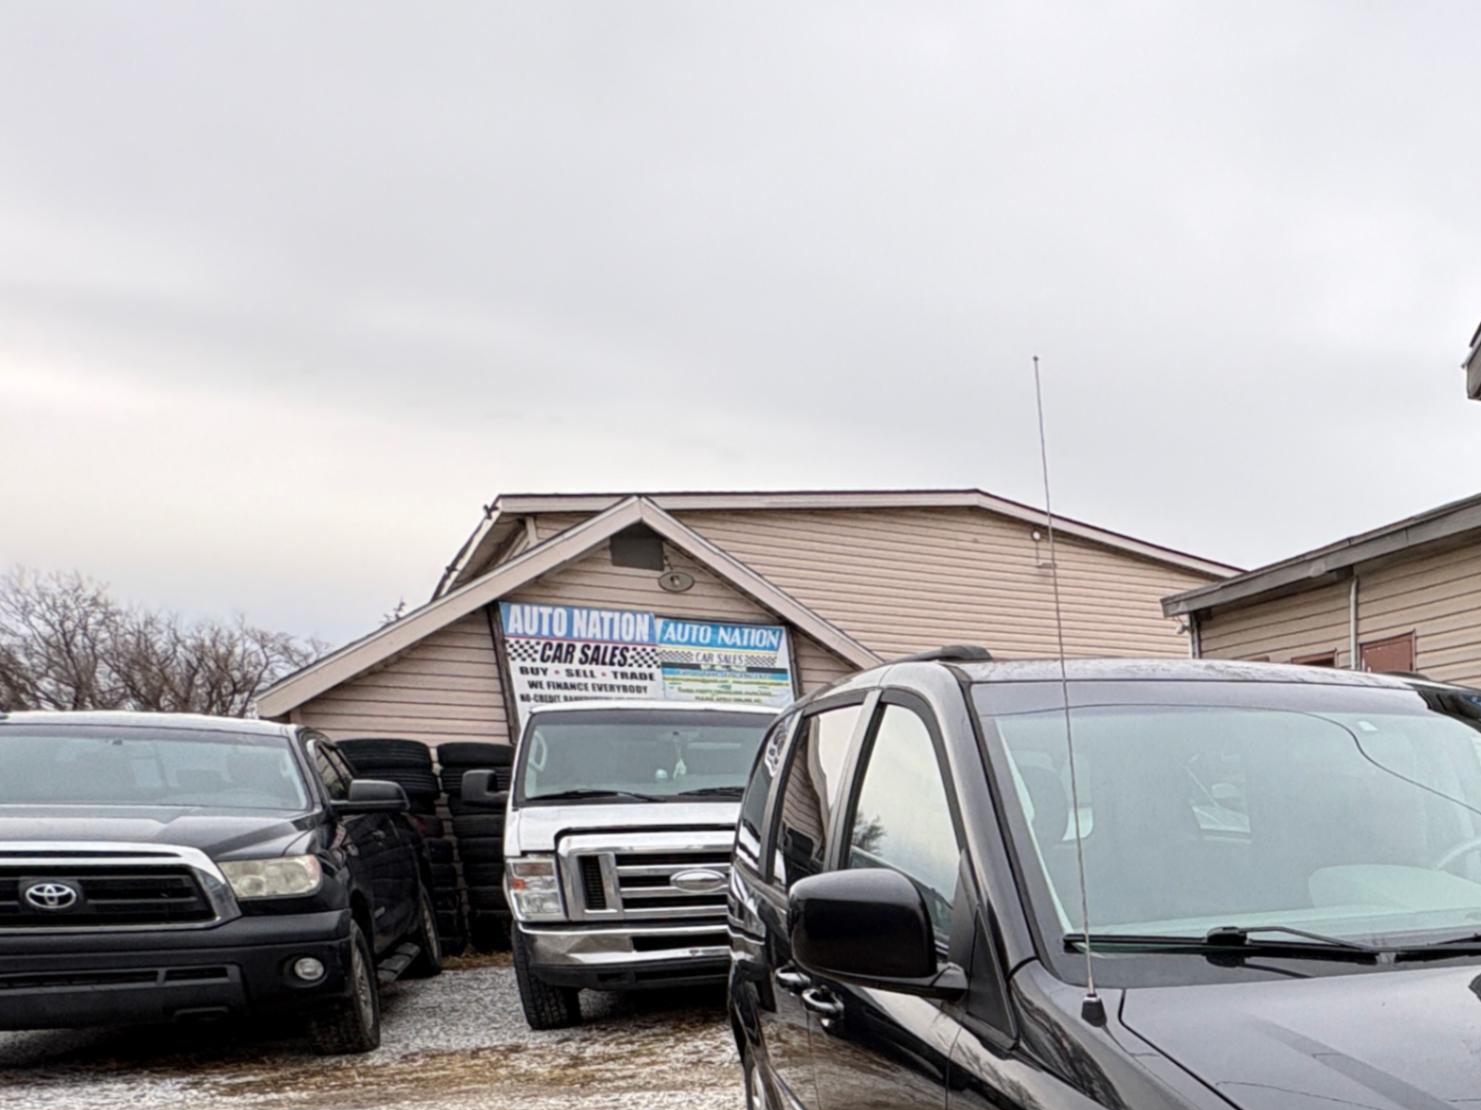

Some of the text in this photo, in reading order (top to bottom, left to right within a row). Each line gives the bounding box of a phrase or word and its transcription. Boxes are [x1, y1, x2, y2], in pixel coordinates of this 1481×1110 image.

[508, 604, 650, 642] AUTO NATION
[664, 621, 780, 649] AUTO NATION
[540, 641, 629, 667] CAR SALES
[695, 651, 745, 665] CAR SALES
[519, 666, 548, 676] BUY
[565, 668, 597, 678] SELL
[611, 670, 657, 681] TRADE
[527, 680, 648, 694] WE FINANCE EVERYBODY
